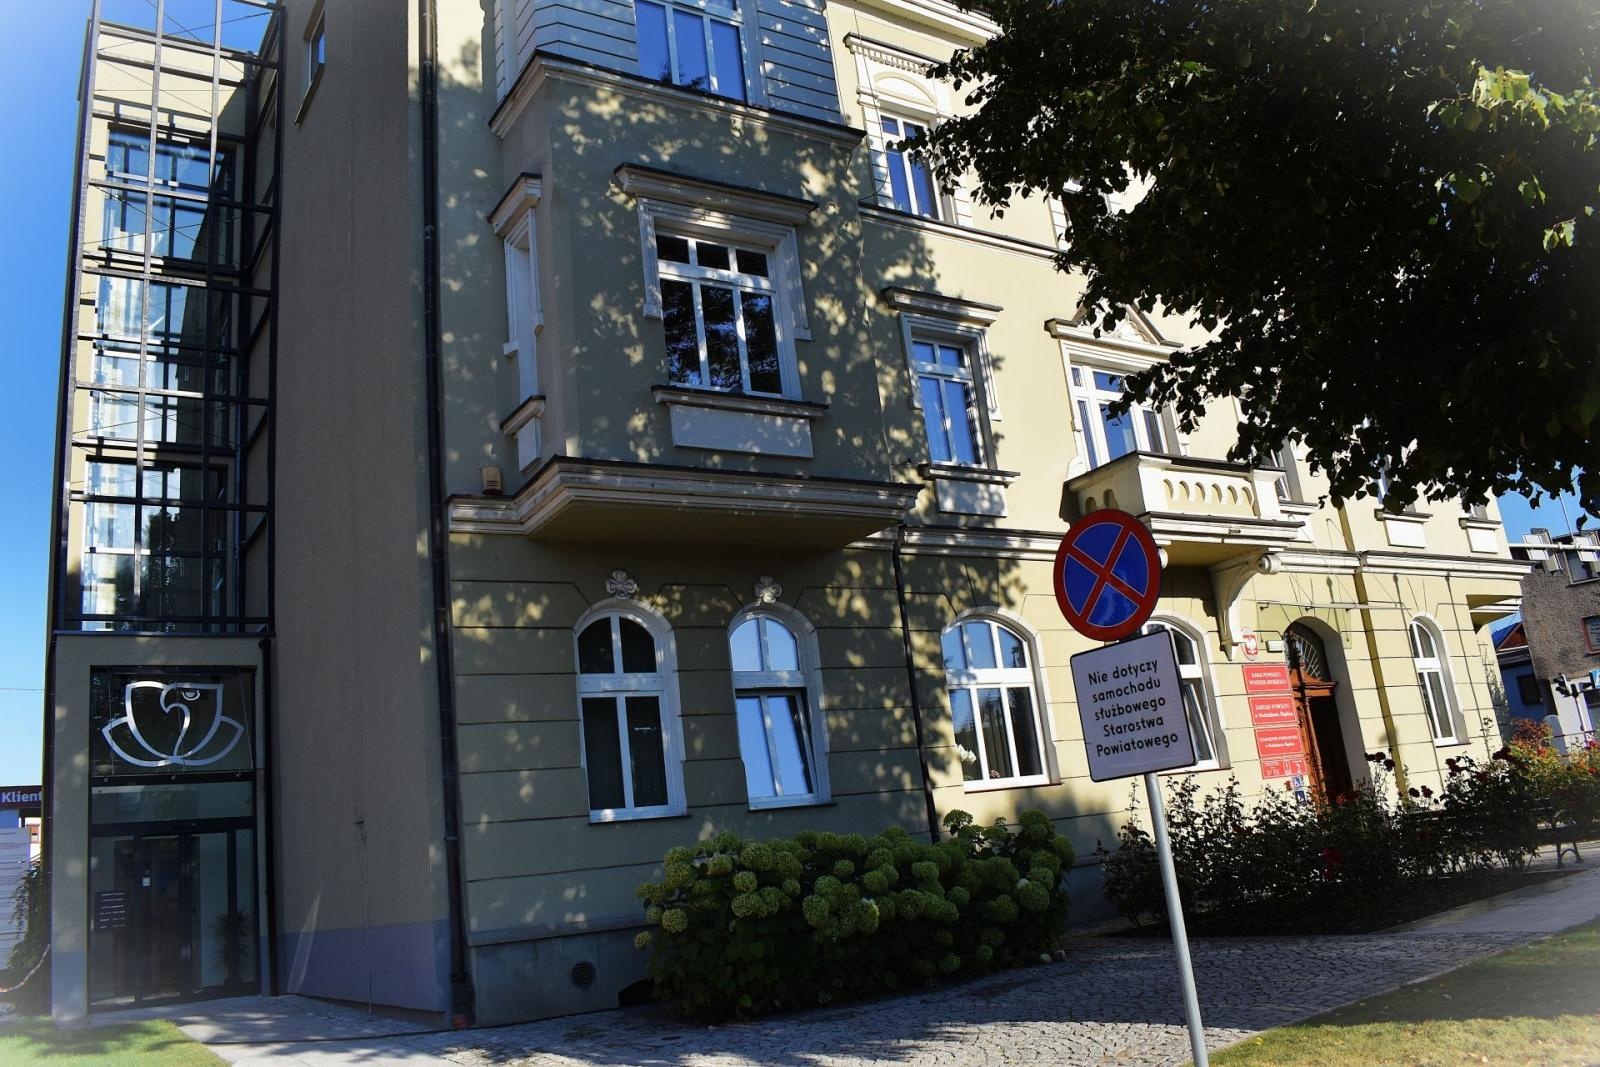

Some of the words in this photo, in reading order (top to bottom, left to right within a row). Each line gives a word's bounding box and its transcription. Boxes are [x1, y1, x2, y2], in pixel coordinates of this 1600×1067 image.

[1088, 672, 1108, 686] Nie
[1112, 659, 1158, 678] dotyczy
[1093, 677, 1161, 703] samochodu
[1095, 696, 1166, 721] służbowego
[1103, 716, 1164, 737] Starostwa
[1096, 733, 1178, 757] Powiatowego
